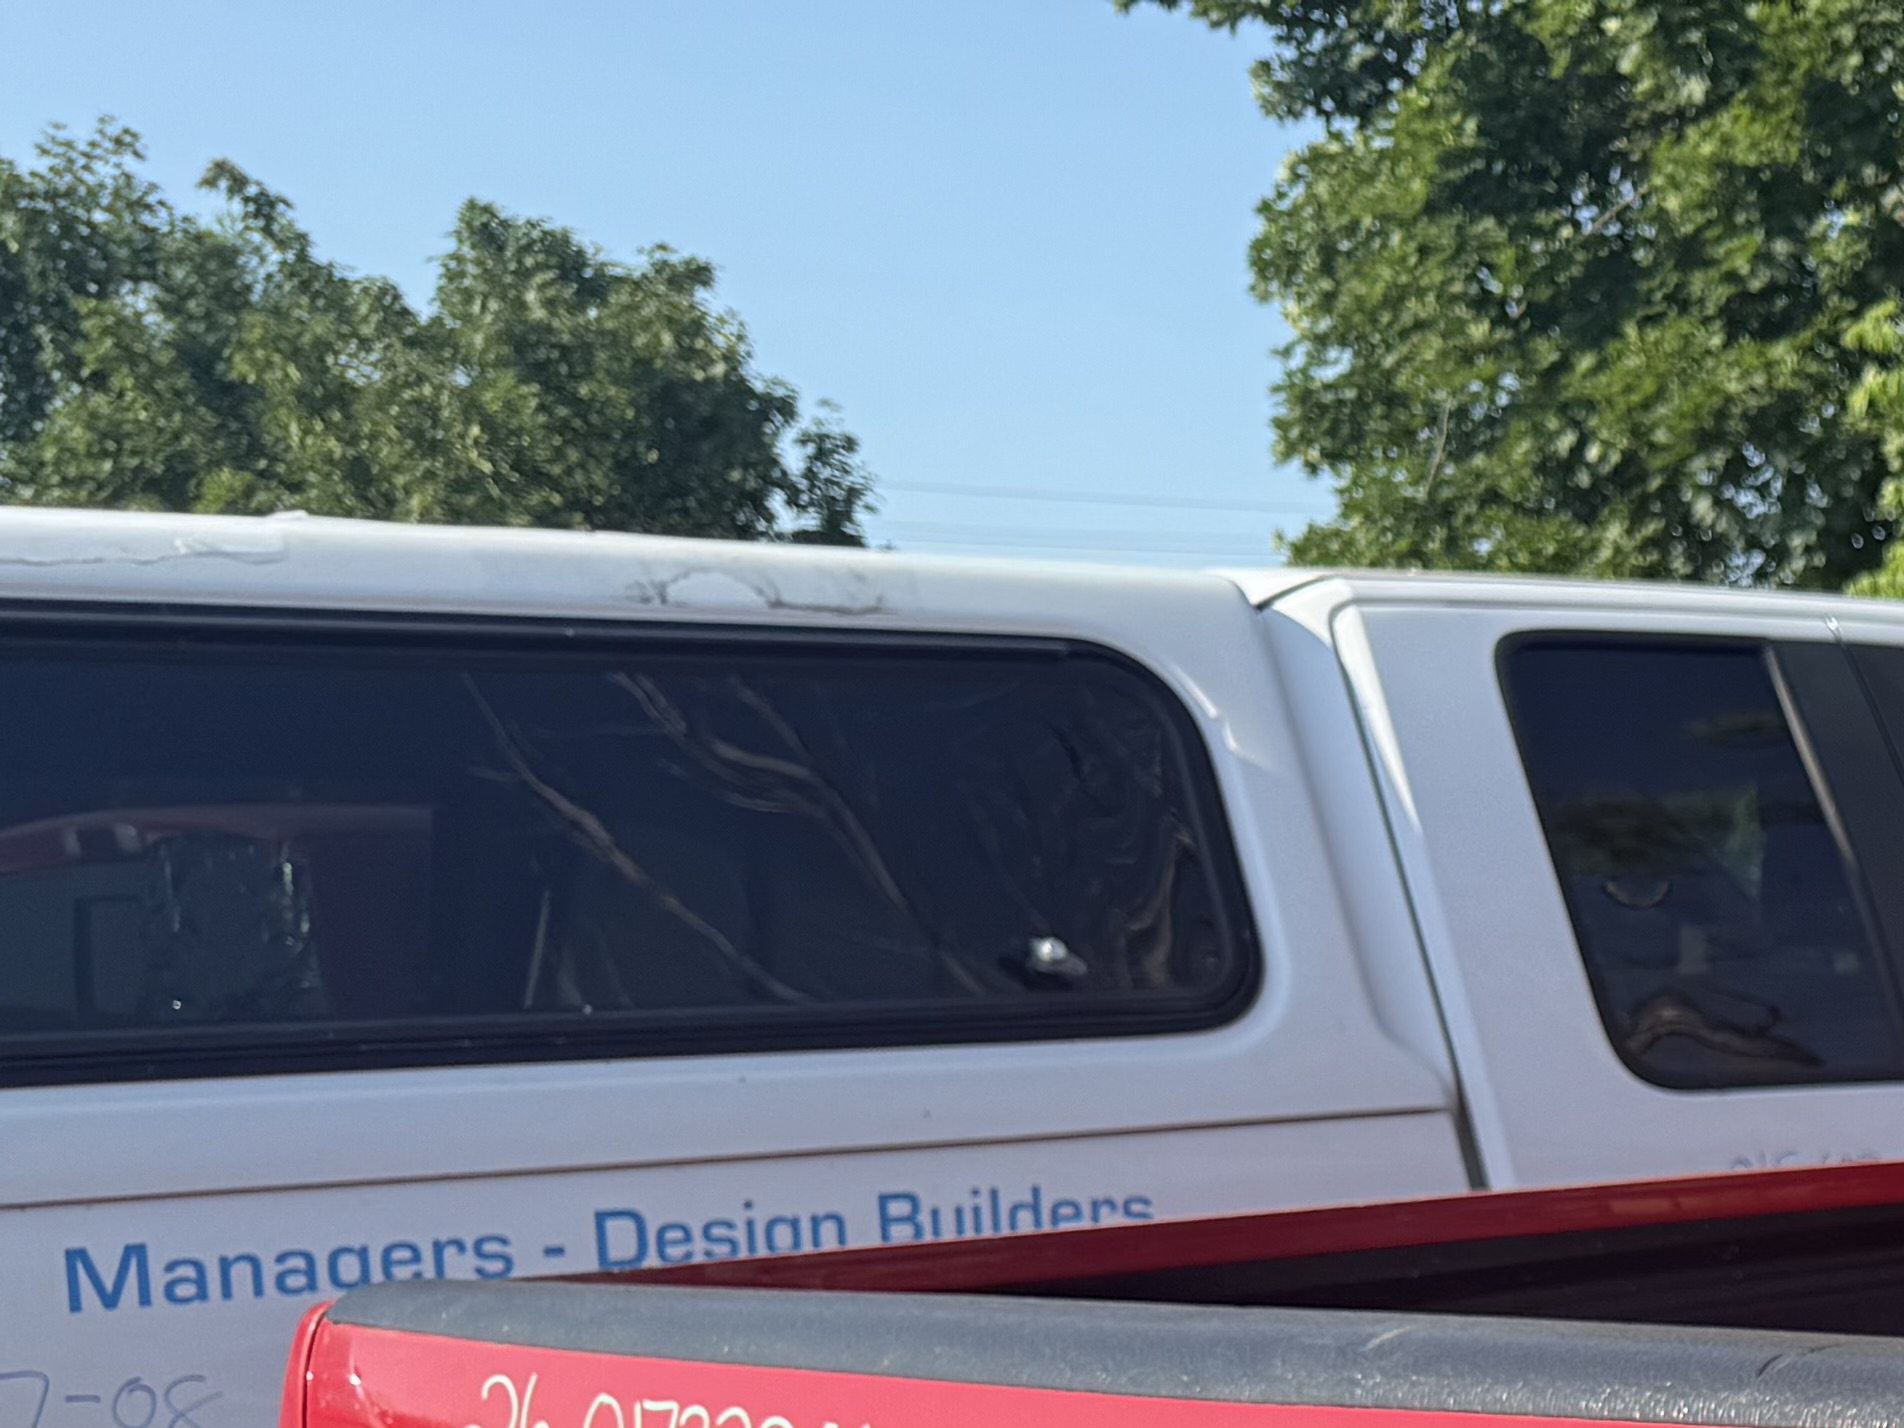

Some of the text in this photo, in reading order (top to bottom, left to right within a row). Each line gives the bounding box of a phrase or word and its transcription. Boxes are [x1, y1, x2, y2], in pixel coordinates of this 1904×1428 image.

[63, 1231, 515, 1314] Managers
[593, 1199, 847, 1271] Design
[876, 1184, 1156, 1243] Builders
